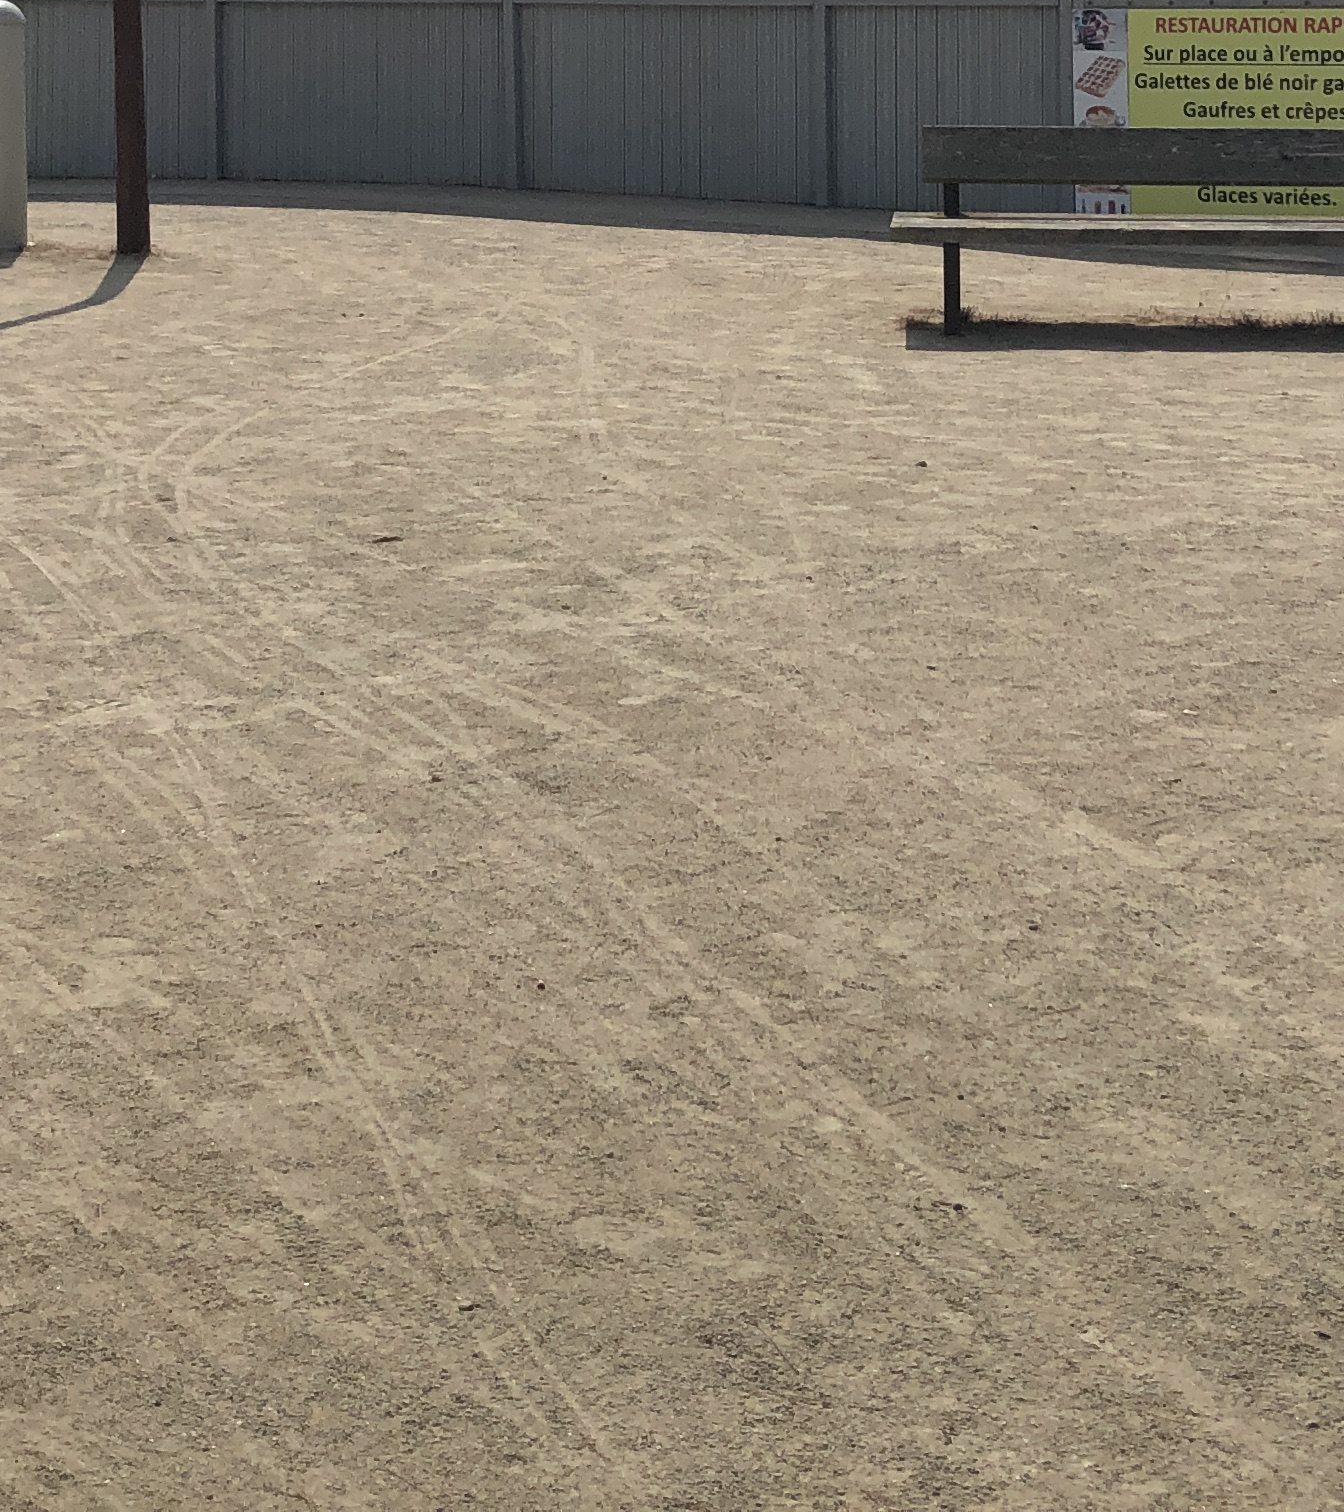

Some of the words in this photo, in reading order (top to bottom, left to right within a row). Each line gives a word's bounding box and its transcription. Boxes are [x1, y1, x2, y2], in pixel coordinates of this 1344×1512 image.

[1155, 16, 1297, 34] RESTAURATION
[1143, 44, 1174, 63] Sur
[1179, 44, 1228, 64] place
[1233, 48, 1257, 63] ou
[1263, 45, 1274, 62] à
[1134, 72, 1211, 91] Galettes
[1215, 72, 1239, 90] de
[1244, 72, 1274, 91] blé
[1279, 73, 1318, 91] noir
[1183, 100, 1256, 119] Gaufres
[1261, 103, 1280, 120] et
[1197, 185, 1258, 204] Glaces
[1262, 187, 1337, 207] variées.
